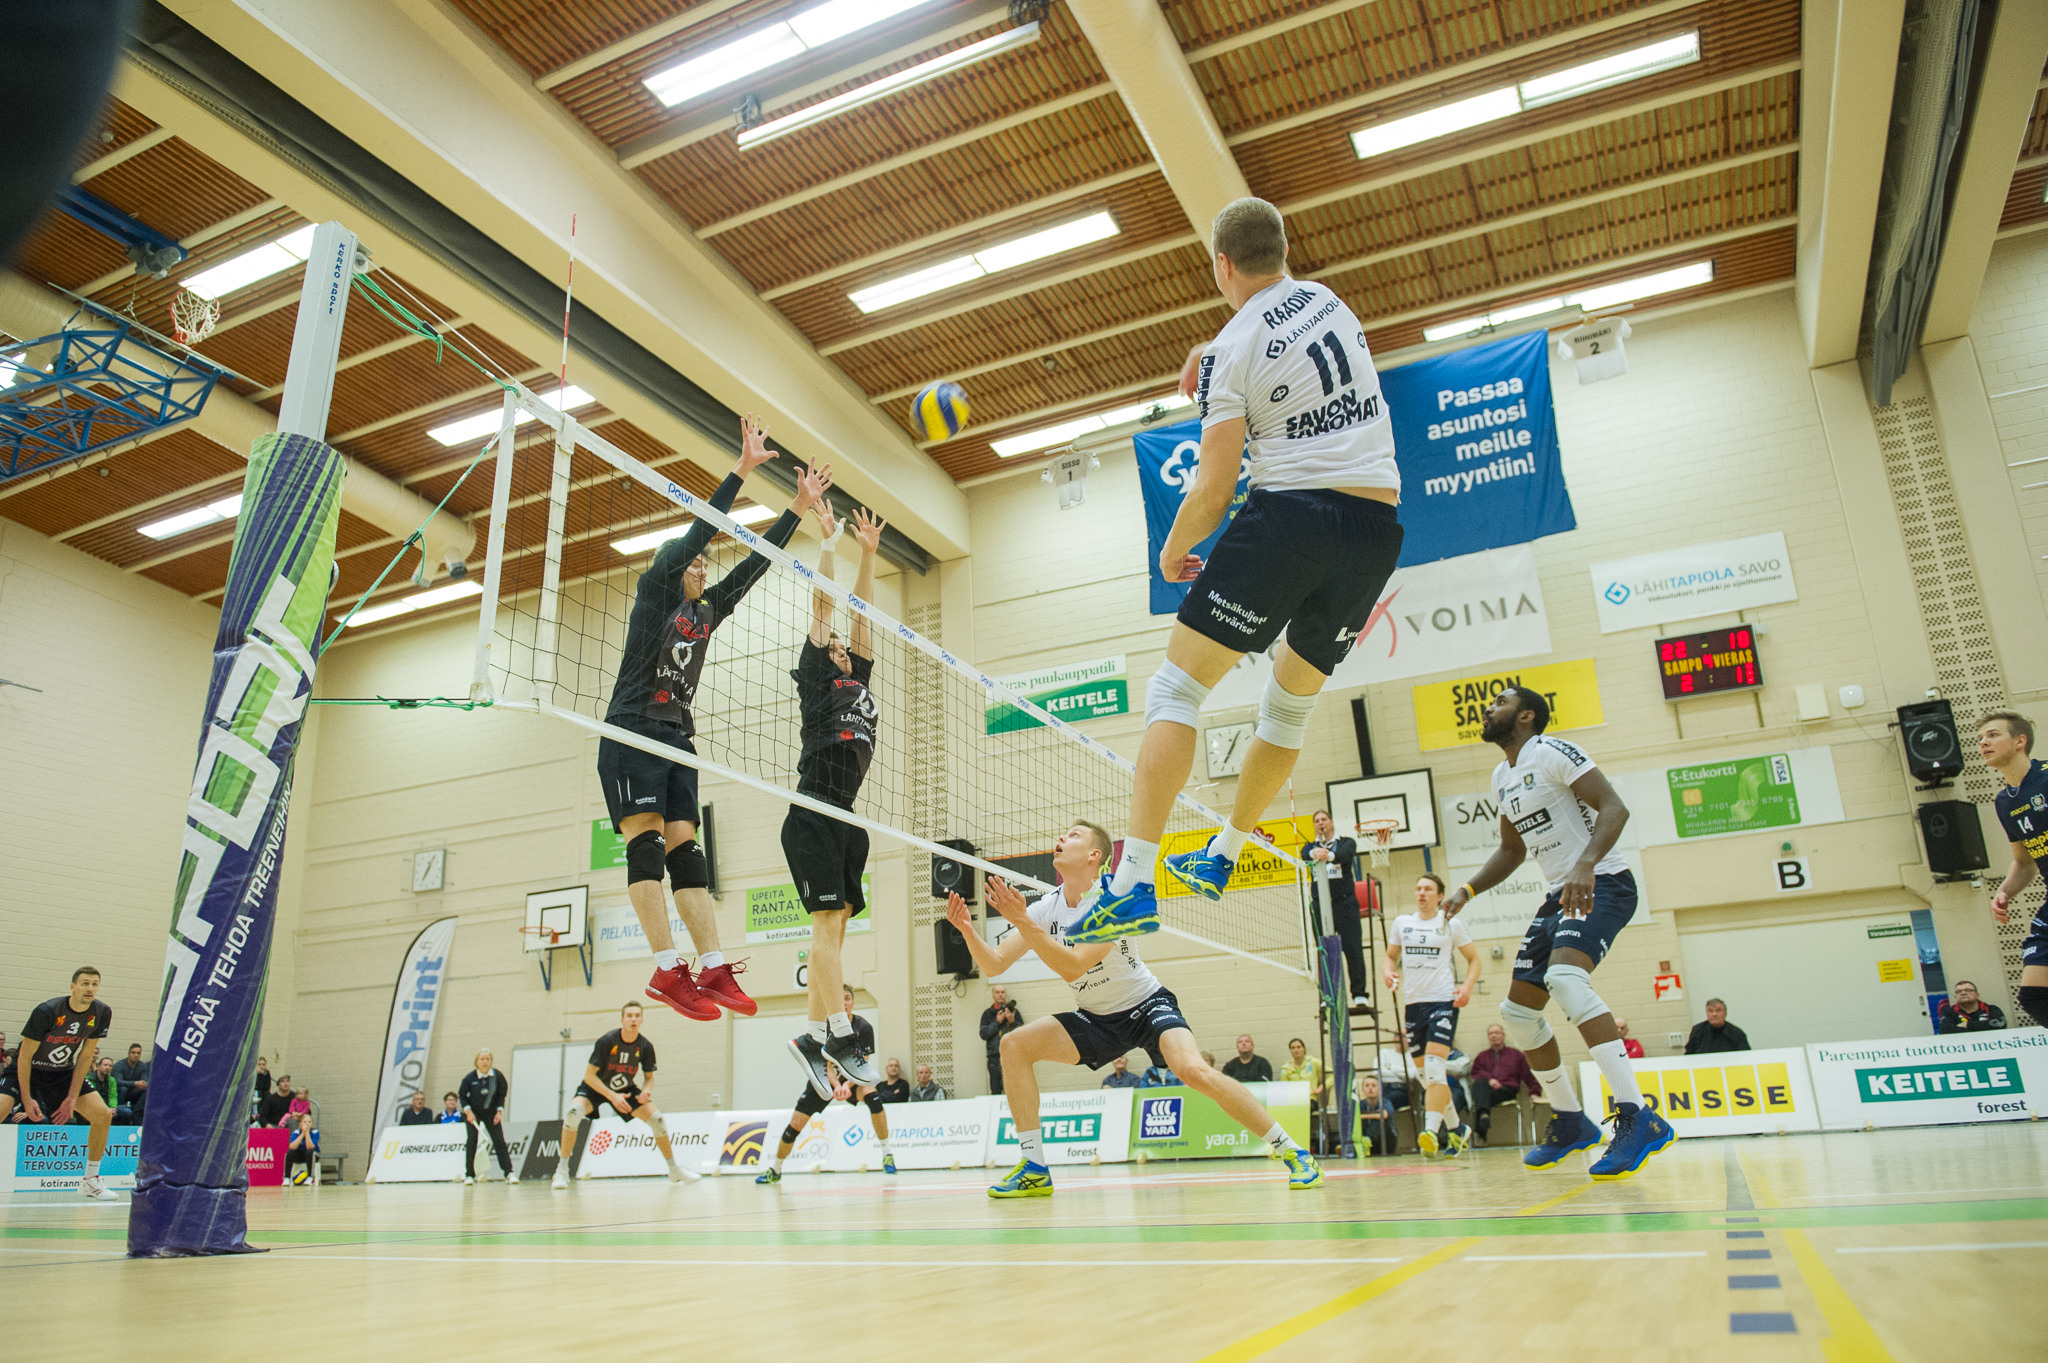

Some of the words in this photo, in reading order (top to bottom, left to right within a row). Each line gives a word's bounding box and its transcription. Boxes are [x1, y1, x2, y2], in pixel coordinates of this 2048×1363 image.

[1590, 342, 1601, 355] 2
[1306, 330, 1353, 396] 11
[1437, 377, 1524, 412] Passaa
[1286, 388, 1357, 432] SAVON
[1427, 399, 1527, 441] asuntosi
[1456, 429, 1532, 461] meille
[1424, 452, 1536, 496] myyntiin!
[1634, 567, 1735, 596] LÄHITAPIOLA
[1738, 559, 1781, 578] SAVO
[1404, 592, 1538, 636] VOIMA
[1661, 640, 1688, 661] 22
[1713, 649, 1753, 668] VIERAS
[1030, 660, 1116, 689] puukauppatili
[1664, 657, 1703, 676] SAMPO
[1680, 673, 1694, 692] 2
[1046, 689, 1118, 712] KEITELE
[1093, 704, 1118, 715] forest
[2017, 816, 2034, 834] 14
[1777, 861, 1805, 889] B
[752, 890, 784, 901] UPEITA
[752, 914, 800, 927] TERVOSSA
[1420, 935, 1426, 944] 3
[176, 994, 220, 1068] LISÄÄ
[207, 914, 254, 989] TEHOA
[66, 1022, 80, 1034] 3
[1818, 1048, 1900, 1063] Parempaa
[1906, 1045, 1967, 1056] tuottoa
[1868, 1066, 2011, 1096] KEITELE
[1608, 1086, 1788, 1113] ONSSE
[1977, 1100, 2028, 1113] forest
[26, 1131, 68, 1141] UPEITA
[948, 1124, 981, 1137] SAVO
[1004, 1119, 1095, 1140] KTELE
[1145, 1125, 1176, 1135] YARA
[1133, 1141, 1167, 1149] Knowledge
[1169, 1140, 1189, 1149] grows
[1205, 1130, 1249, 1150] yara.fi
[25, 1144, 139, 1157] RANTATNTTE
[1067, 1147, 1098, 1157] forest
[24, 1161, 84, 1171] TERVOSSA
